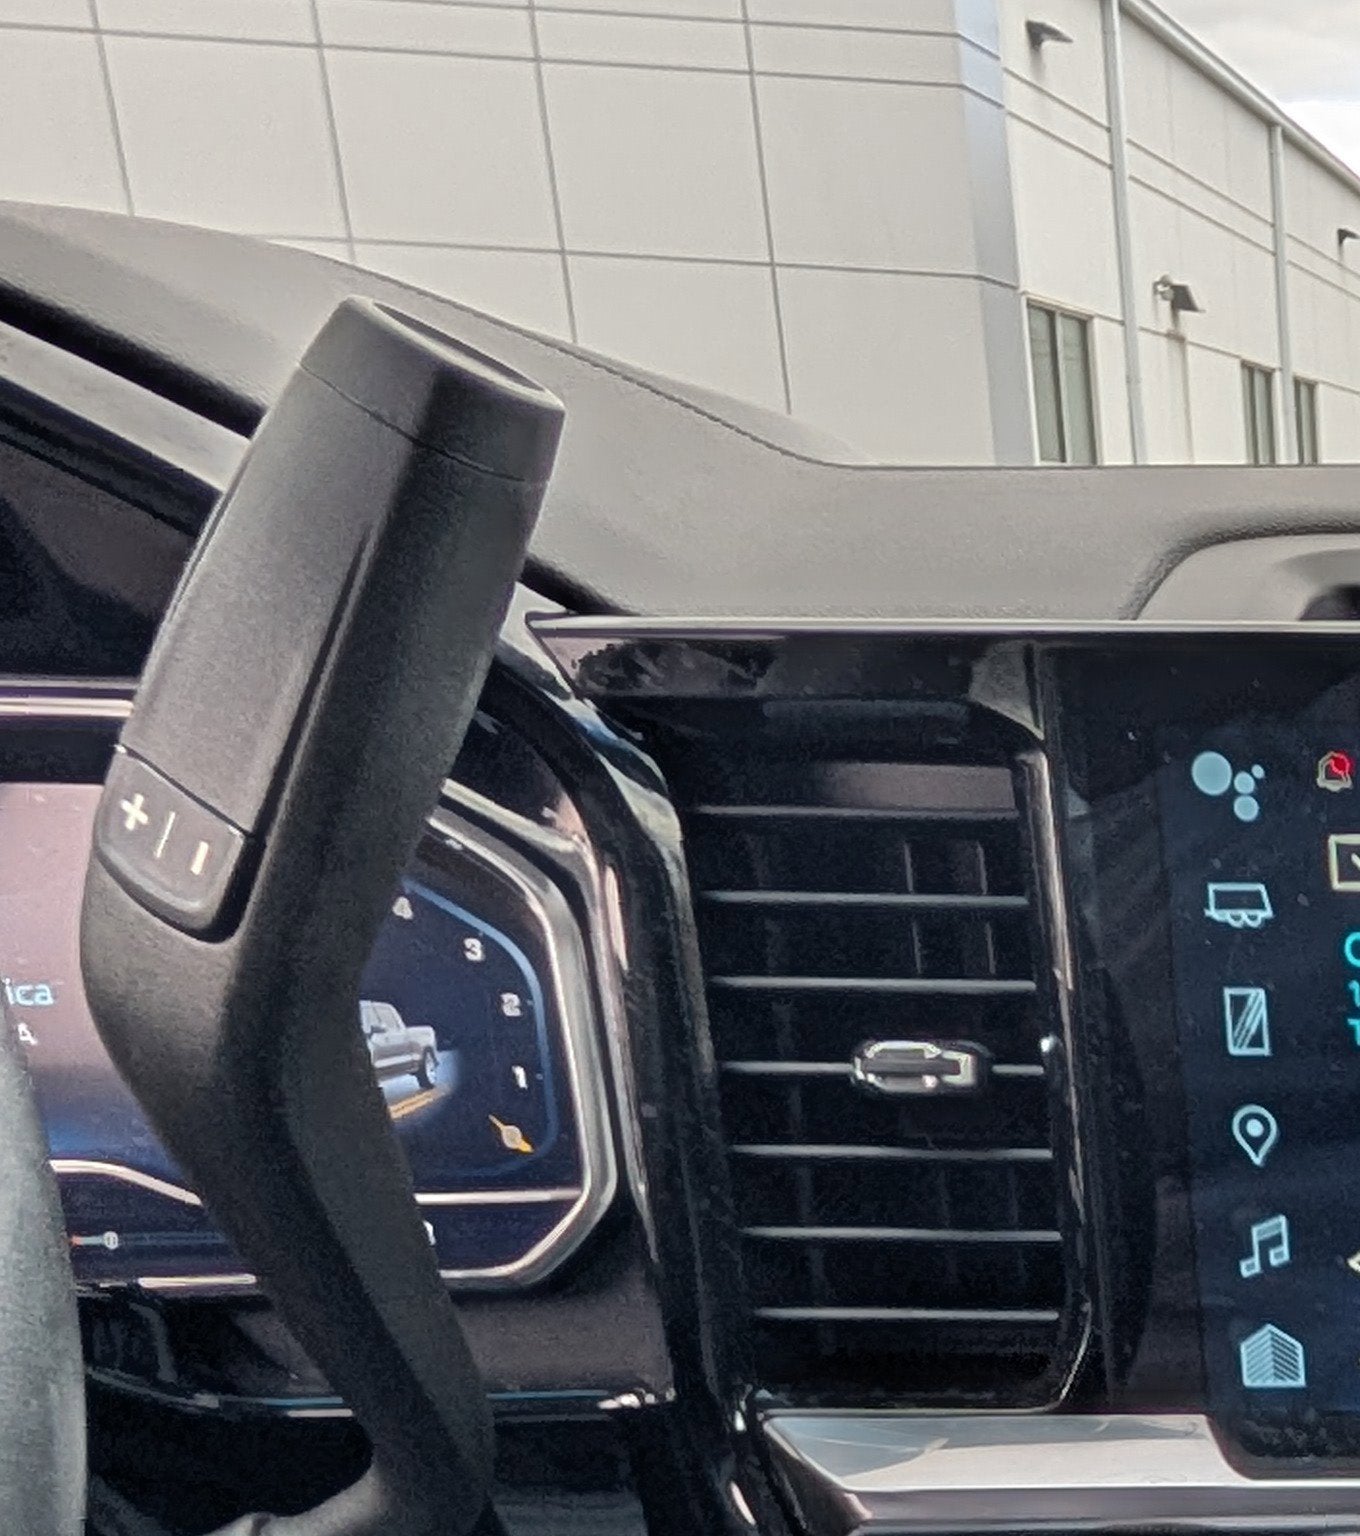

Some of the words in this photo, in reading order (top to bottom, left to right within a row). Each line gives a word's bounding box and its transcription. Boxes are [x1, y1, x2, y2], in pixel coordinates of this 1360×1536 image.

[392, 896, 414, 920] 4
[464, 938, 484, 961] 3
[501, 992, 522, 1017] 2
[512, 1065, 528, 1090] 1
